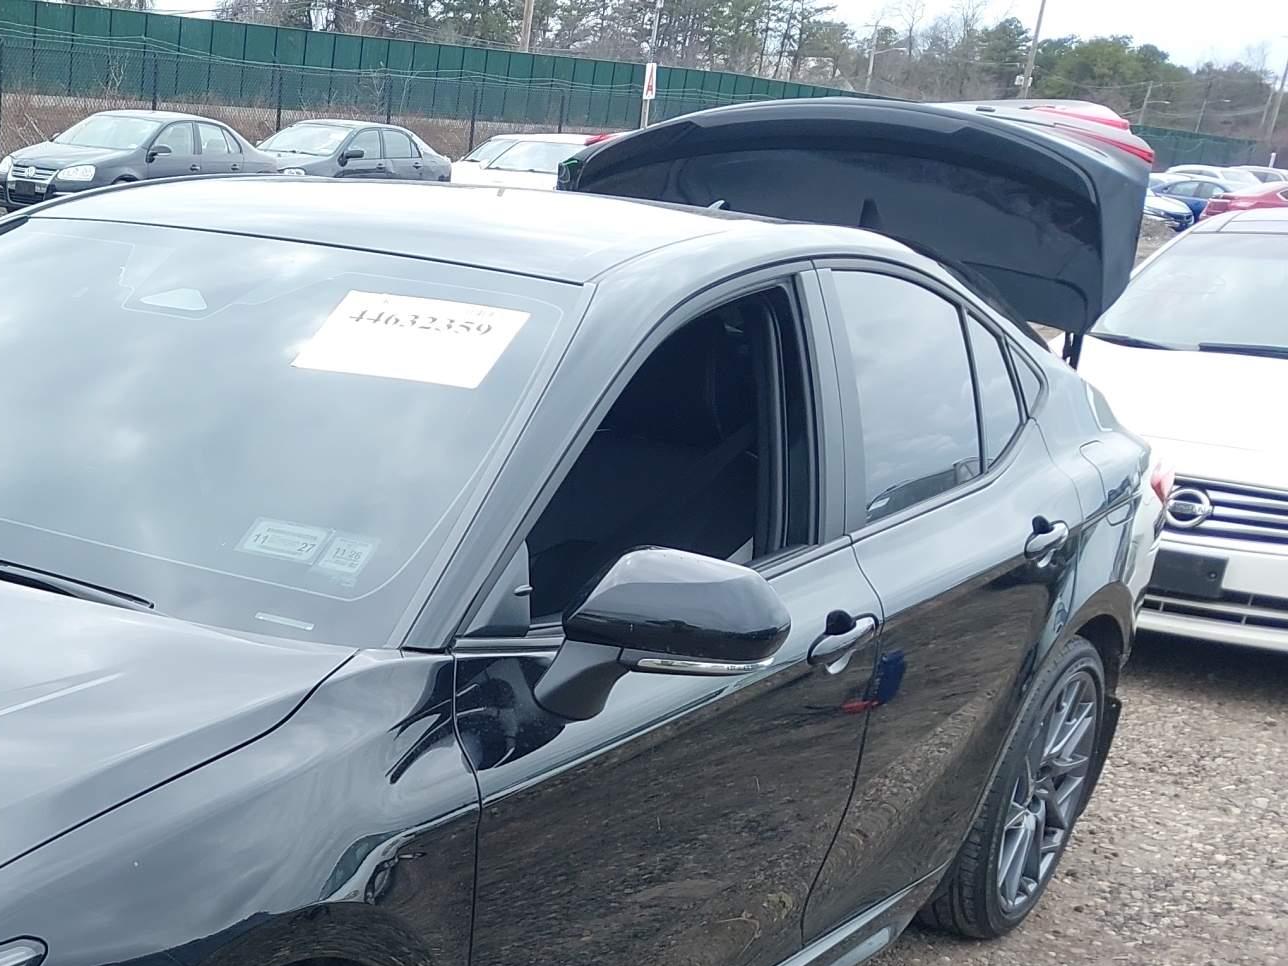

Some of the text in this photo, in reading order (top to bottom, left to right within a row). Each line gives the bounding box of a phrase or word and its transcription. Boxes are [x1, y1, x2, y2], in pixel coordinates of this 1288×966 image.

[349, 309, 493, 335] 44632359
[253, 533, 269, 545] 11
[296, 542, 316, 553] 27
